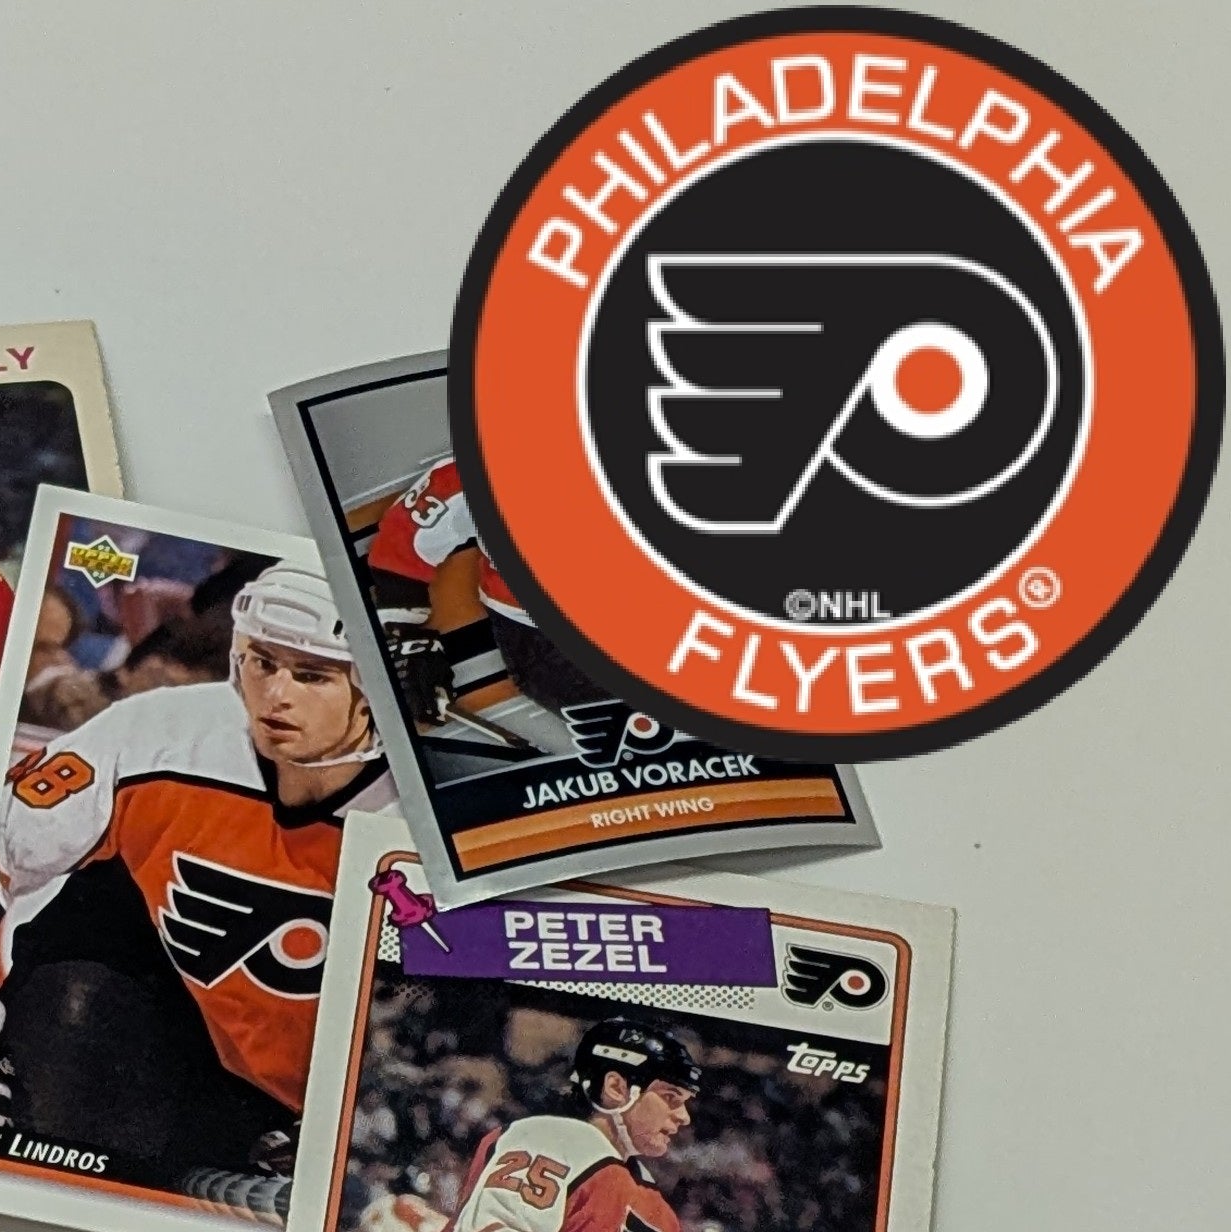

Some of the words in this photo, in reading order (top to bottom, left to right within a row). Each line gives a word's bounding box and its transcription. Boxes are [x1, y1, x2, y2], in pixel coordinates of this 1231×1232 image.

[523, 771, 619, 809] JAKUB
[621, 754, 761, 789] VORACEK
[590, 803, 652, 828] RIGHT
[653, 796, 715, 818] WING
[503, 910, 665, 943] PETER
[508, 940, 668, 973] ZEZEL
[8, 1133, 110, 1174] LINDROS
[484, 1150, 572, 1211] 25
